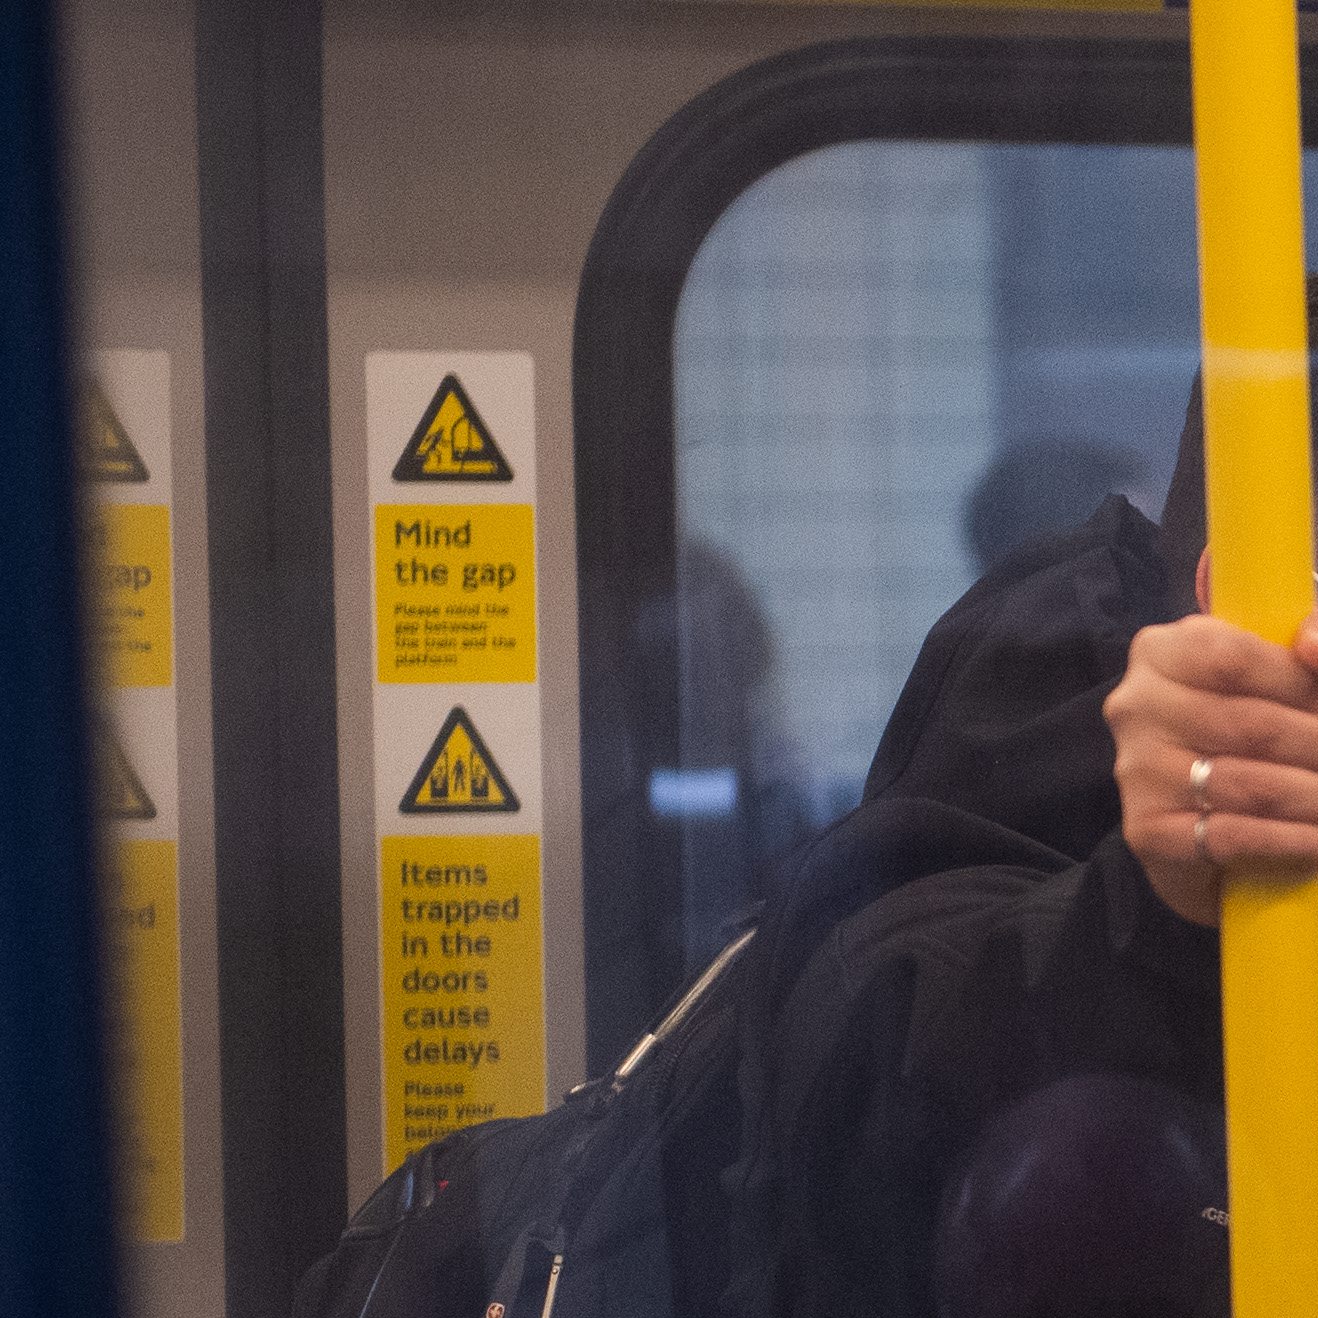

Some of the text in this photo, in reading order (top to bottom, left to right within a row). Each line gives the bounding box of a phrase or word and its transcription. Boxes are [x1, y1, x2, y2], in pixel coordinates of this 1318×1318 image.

[394, 519, 471, 547] Mind
[395, 559, 516, 592] the gap
[395, 604, 440, 616] Please
[486, 604, 509, 616] the
[395, 621, 486, 636] gap between
[492, 637, 516, 648] the
[395, 655, 457, 667] platform
[402, 863, 488, 886] Items
[402, 895, 520, 926] trapped
[402, 931, 491, 957] in the
[402, 969, 488, 993] doors
[403, 1008, 490, 1030] cause
[403, 1039, 500, 1069] delays
[404, 1081, 464, 1097] Please
[404, 1104, 494, 1120] keep your
